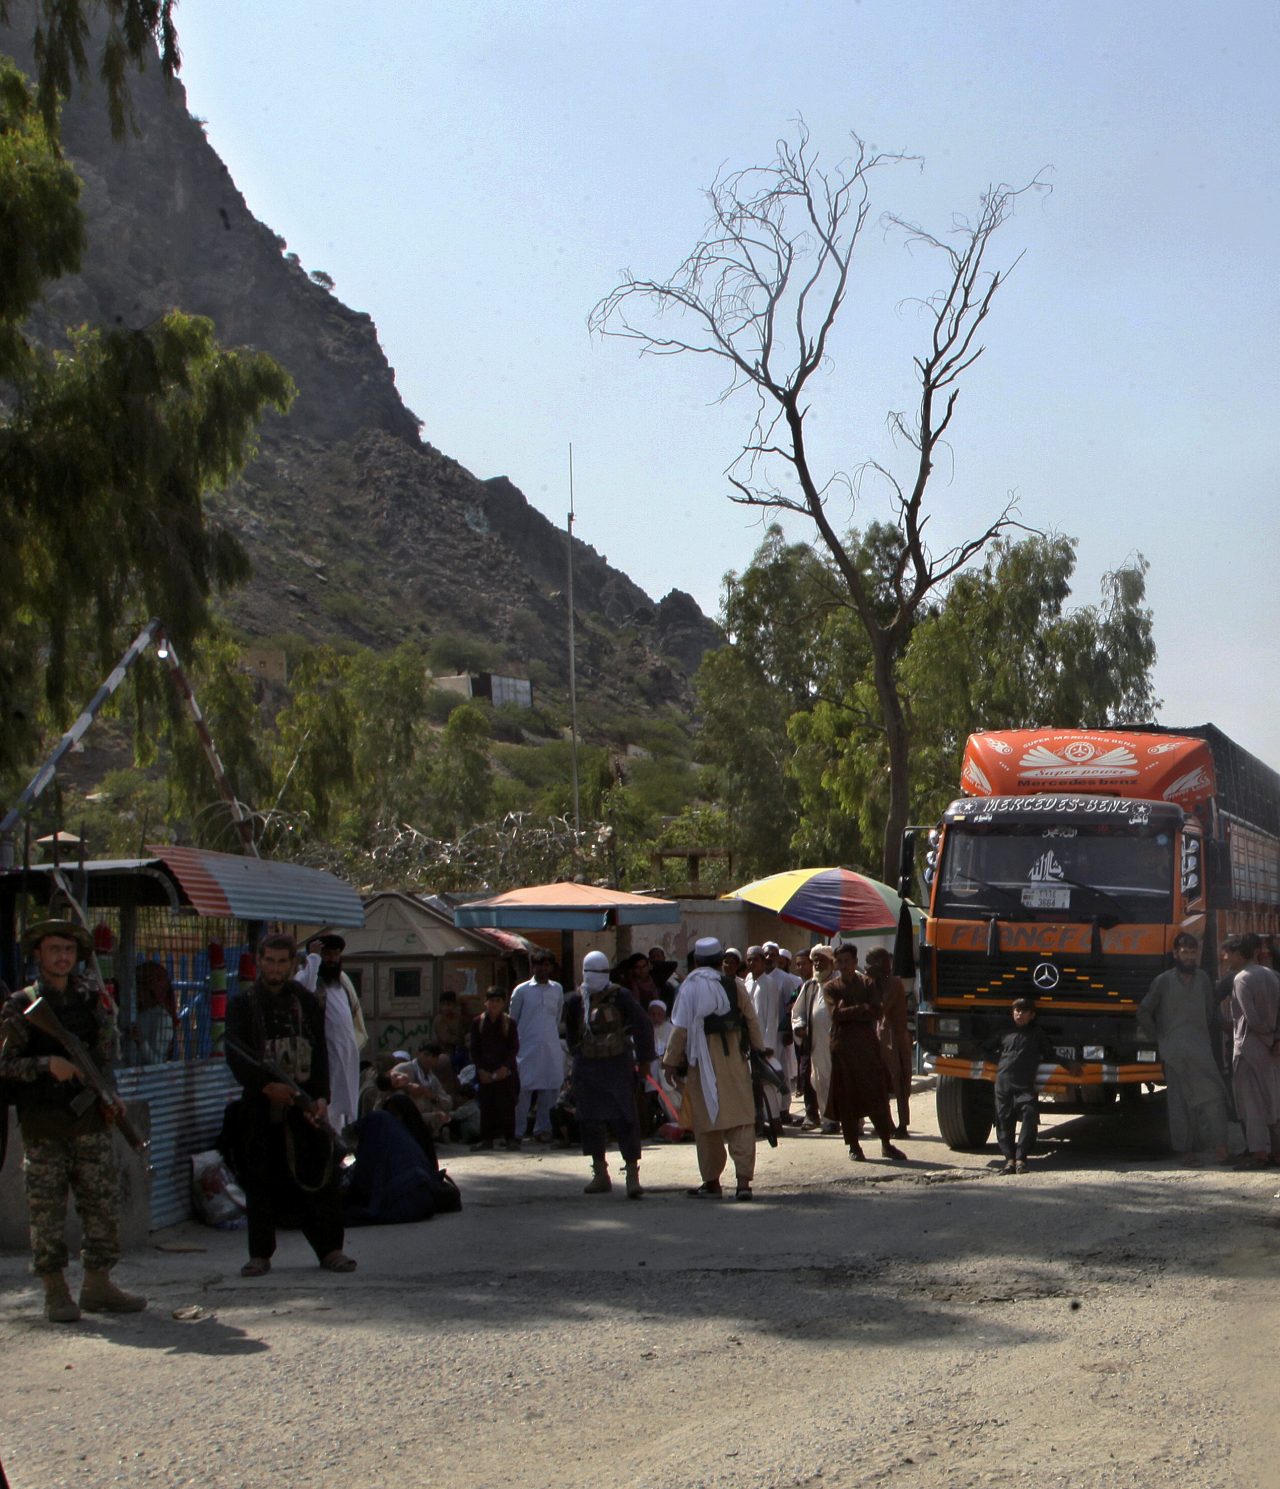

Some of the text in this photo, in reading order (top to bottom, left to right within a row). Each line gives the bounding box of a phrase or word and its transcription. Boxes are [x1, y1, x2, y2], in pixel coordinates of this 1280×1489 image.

[1035, 768, 1078, 777] Super
[1017, 779, 1097, 788] Mercedes
[982, 798, 1132, 814] MERCEDES-BENZ
